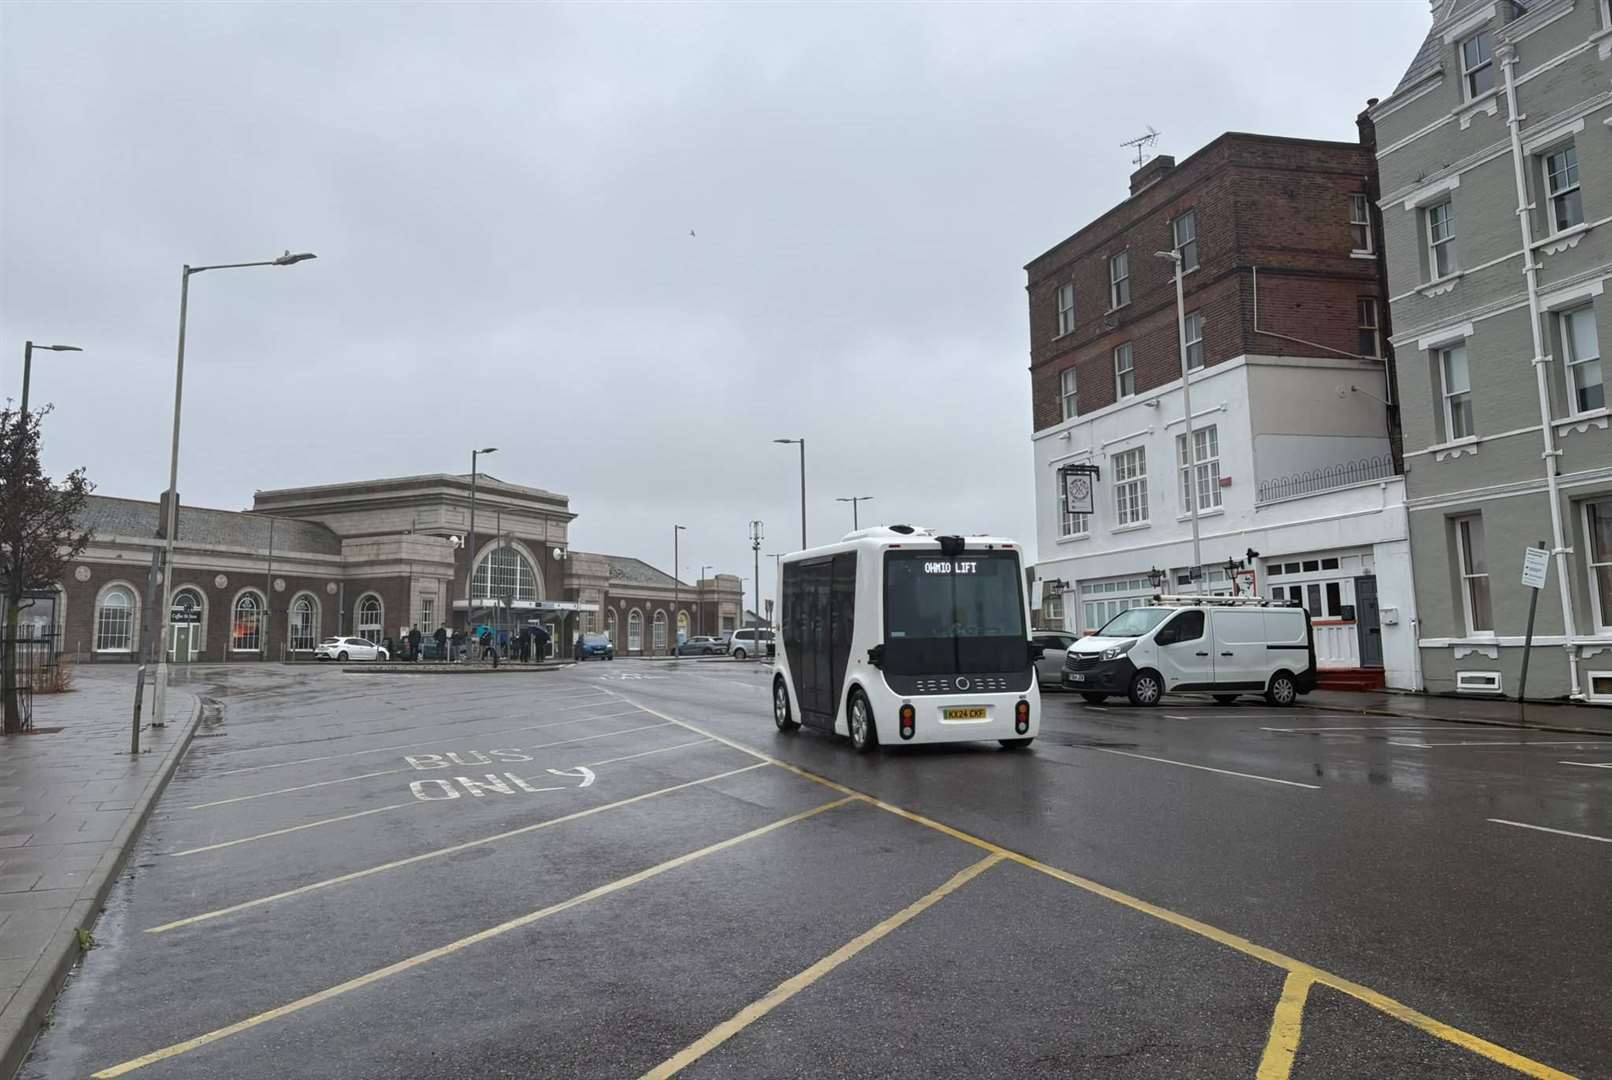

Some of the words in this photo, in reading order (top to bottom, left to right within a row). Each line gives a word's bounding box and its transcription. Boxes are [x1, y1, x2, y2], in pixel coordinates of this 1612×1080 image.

[924, 561, 951, 573] OHMIO
[955, 561, 977, 573] LIFT
[403, 747, 533, 770] BUS
[409, 765, 596, 801] ONLY
